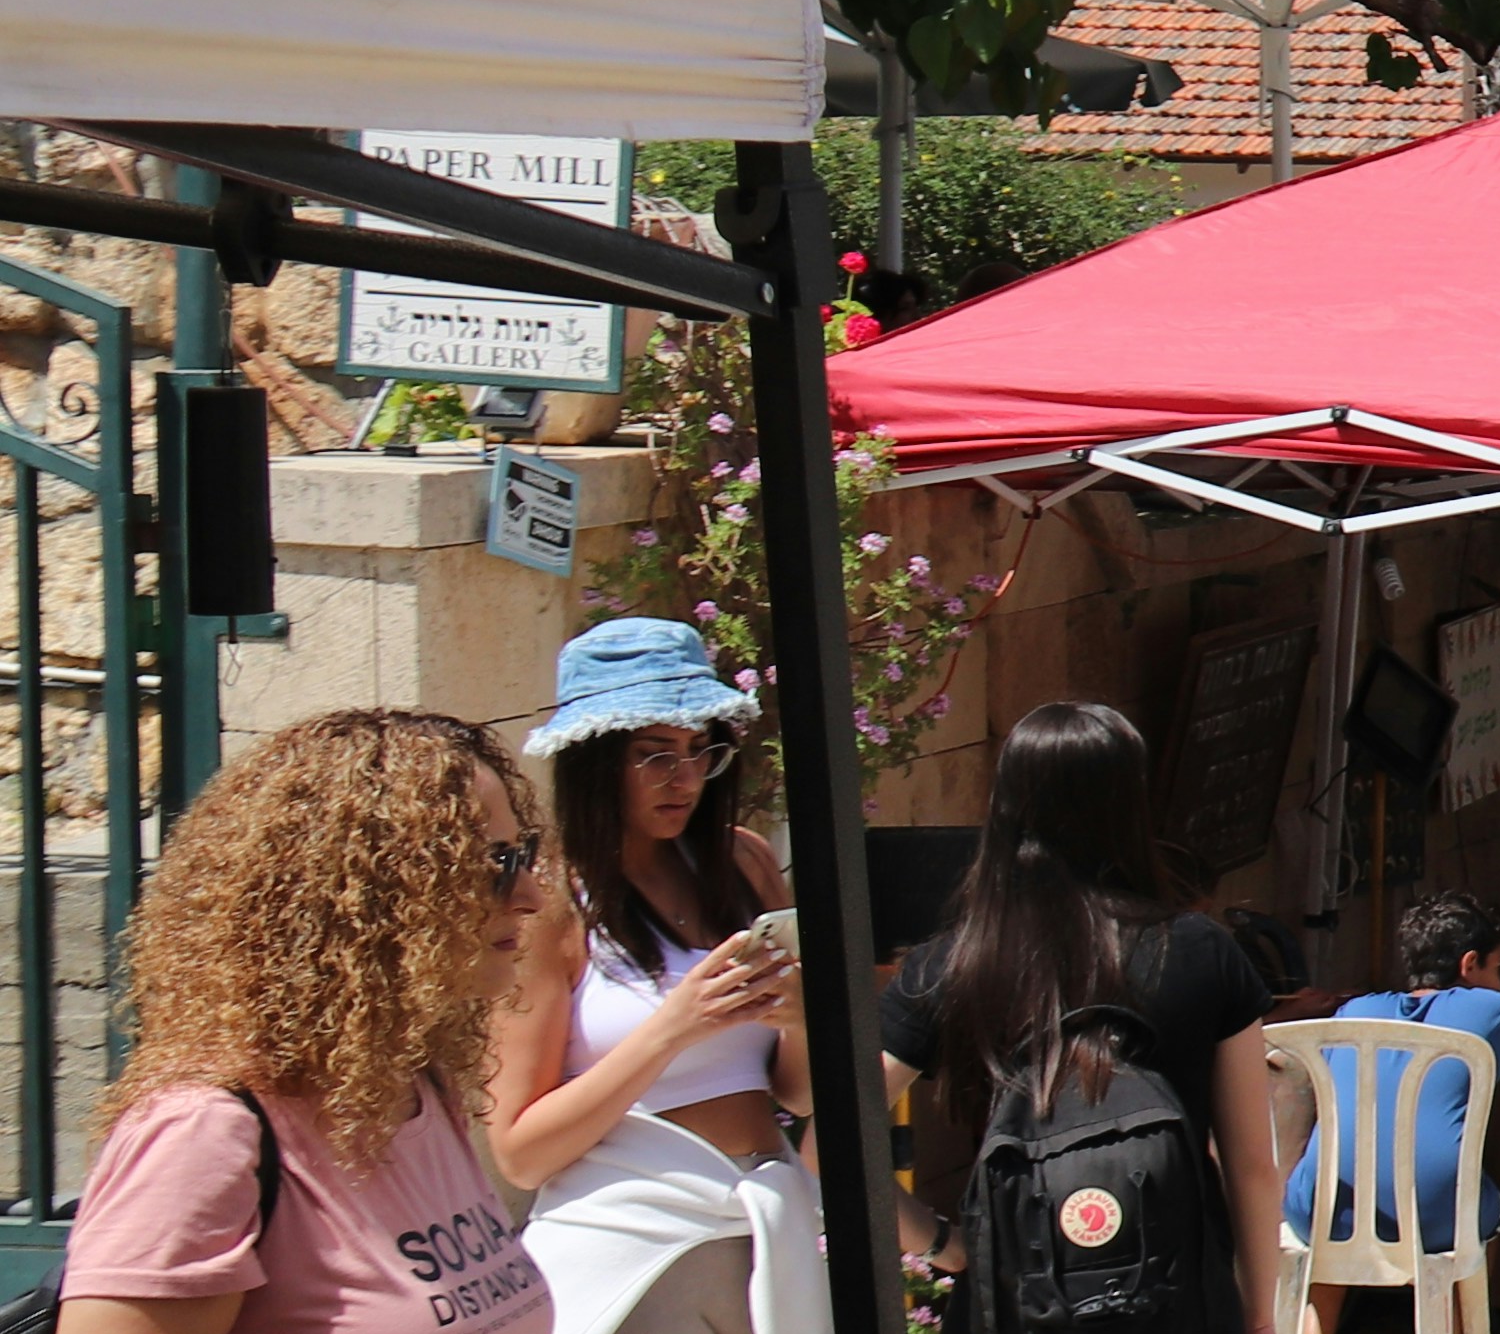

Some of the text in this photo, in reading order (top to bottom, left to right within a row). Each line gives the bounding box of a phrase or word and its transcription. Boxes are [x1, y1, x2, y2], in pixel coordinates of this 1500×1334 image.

[511, 153, 613, 187] MILL
[410, 304, 552, 344] חנות גלריה
[407, 340, 551, 371] GALLERY
